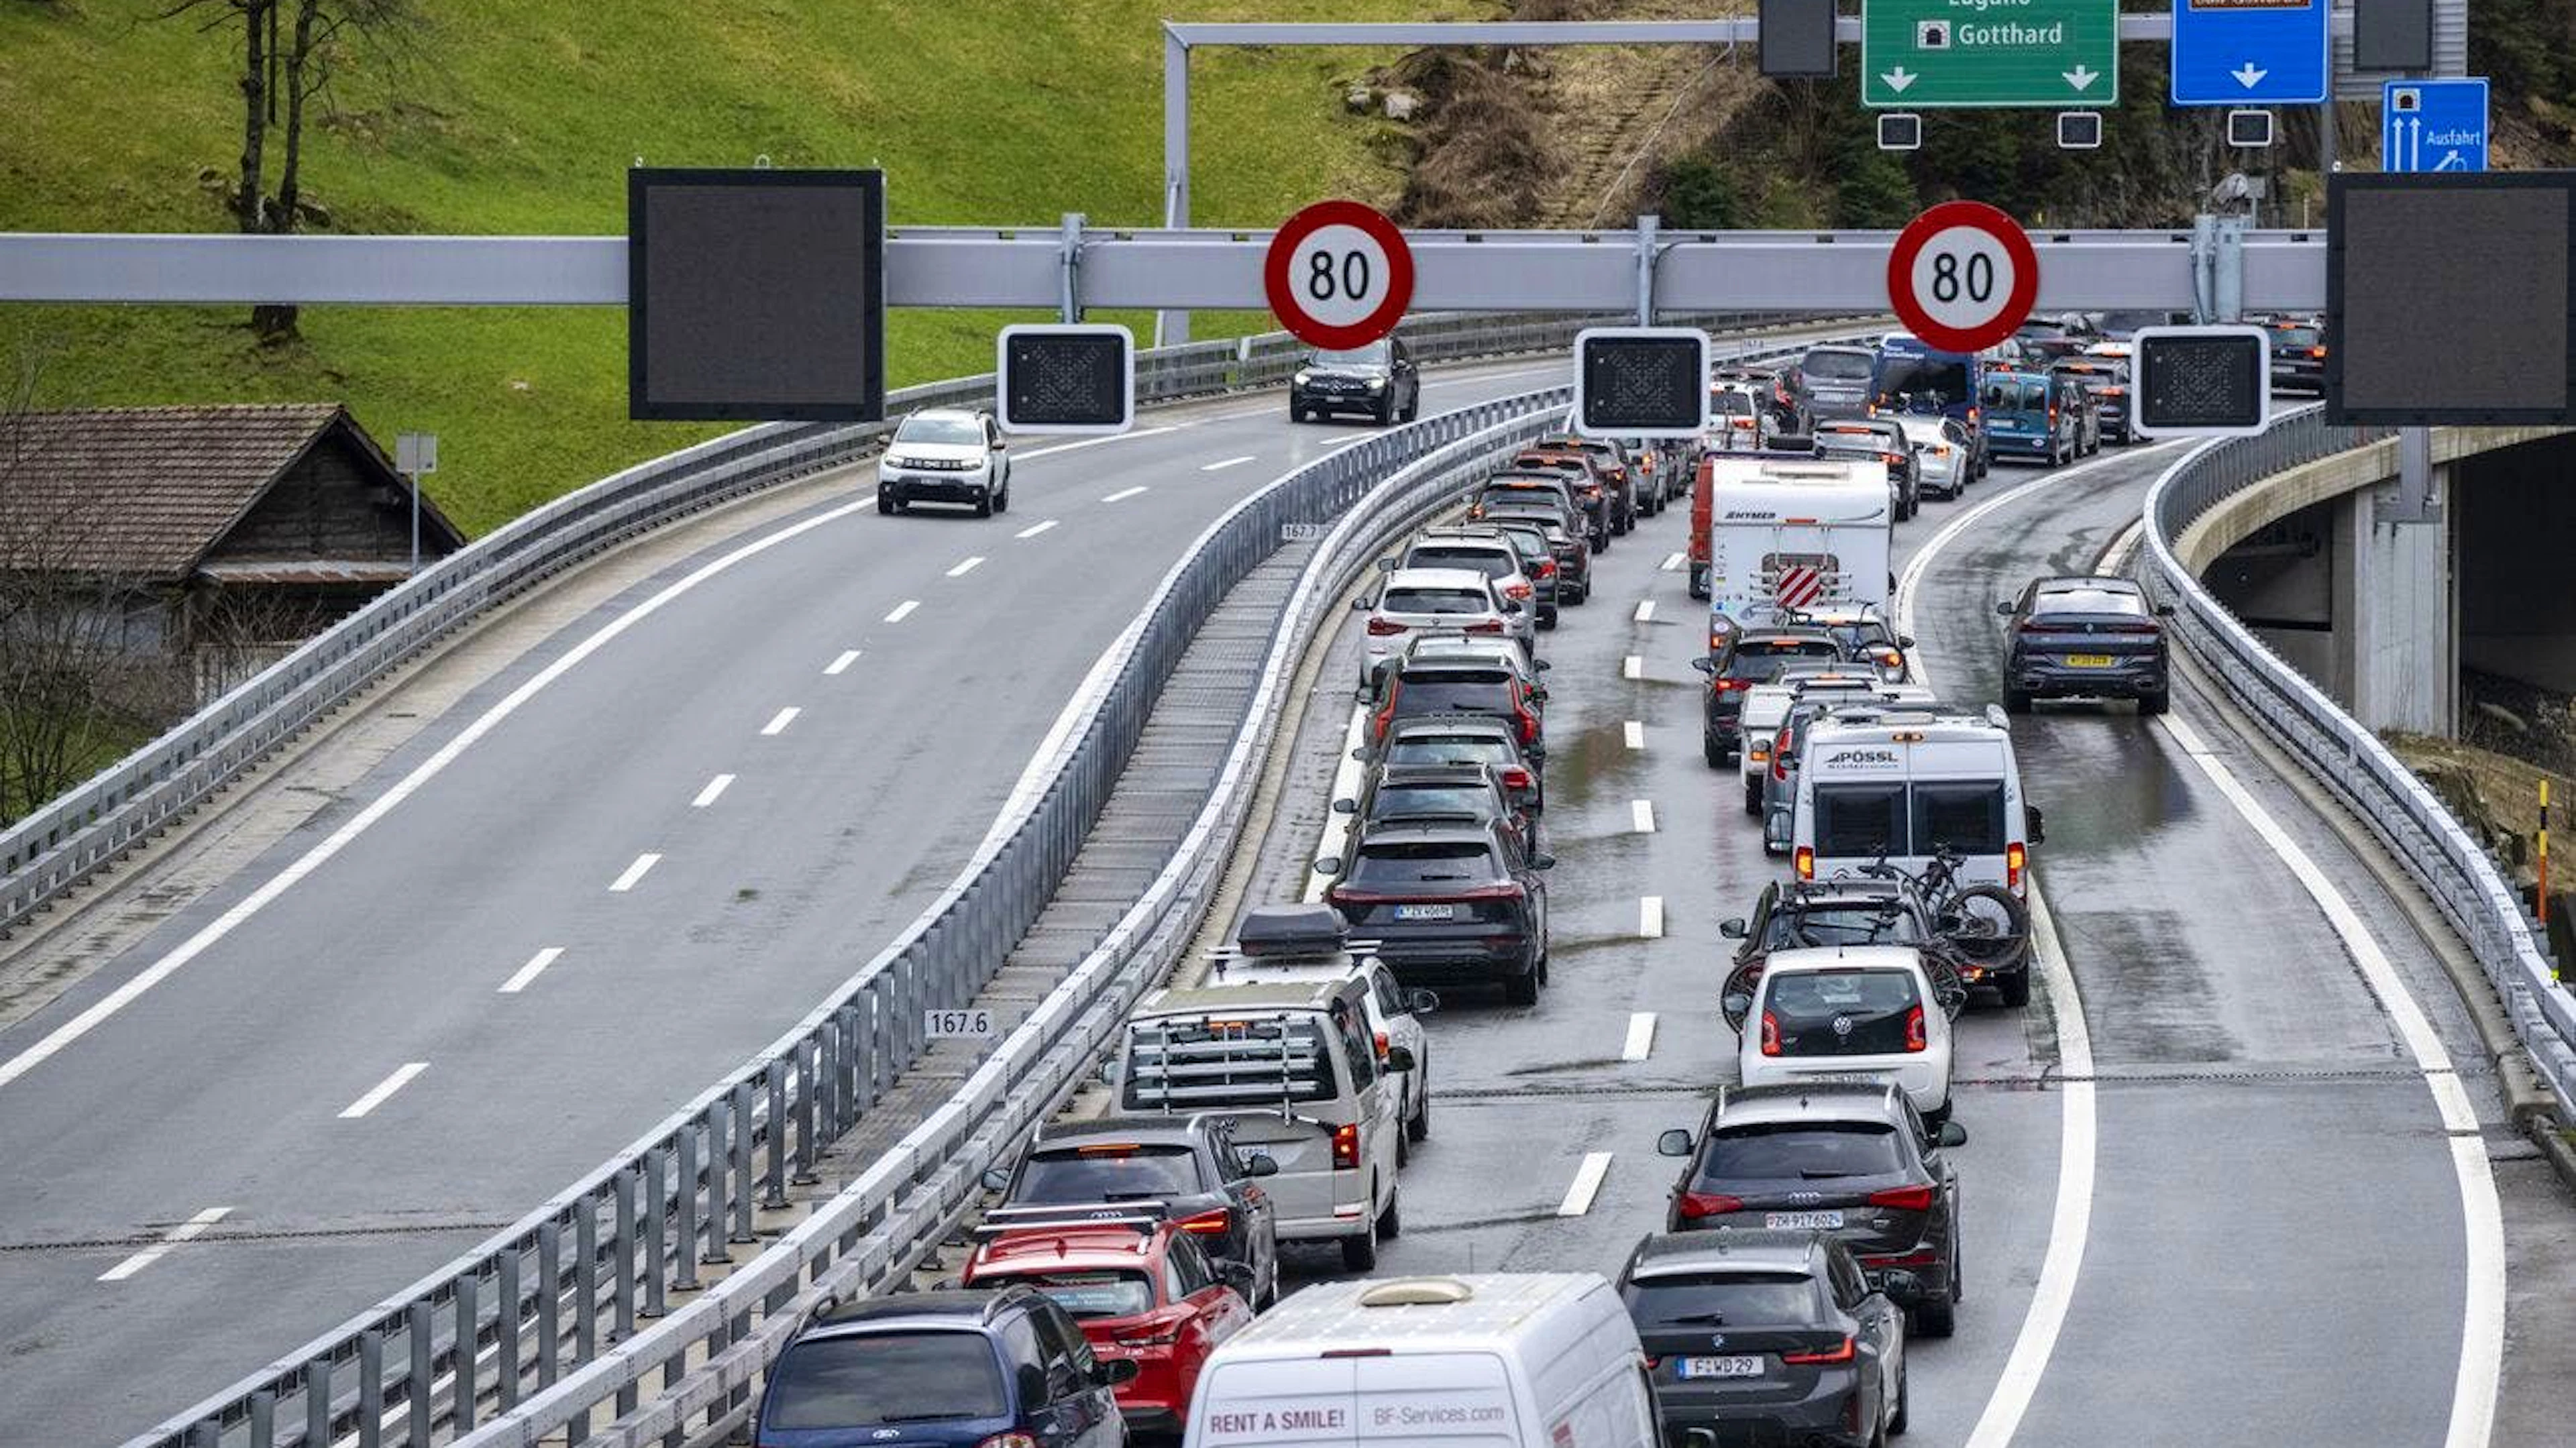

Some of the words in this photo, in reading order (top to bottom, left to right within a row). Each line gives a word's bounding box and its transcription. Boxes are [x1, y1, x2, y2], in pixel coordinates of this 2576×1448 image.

[1958, 21, 2062, 45] Gotthard
[2425, 129, 2481, 146] Ausfahrt
[1309, 249, 1370, 300] 80
[1932, 252, 1994, 303] 80
[1286, 526, 1316, 537] 167.7
[1840, 748, 1898, 763] PÖSSL
[932, 1012, 987, 1032] 167.6
[1211, 1414, 1258, 1433] RENT
[1264, 1412, 1276, 1432] A
[1281, 1410, 1345, 1431] SMILE!
[1375, 1407, 1505, 1426] BF-Services.com
